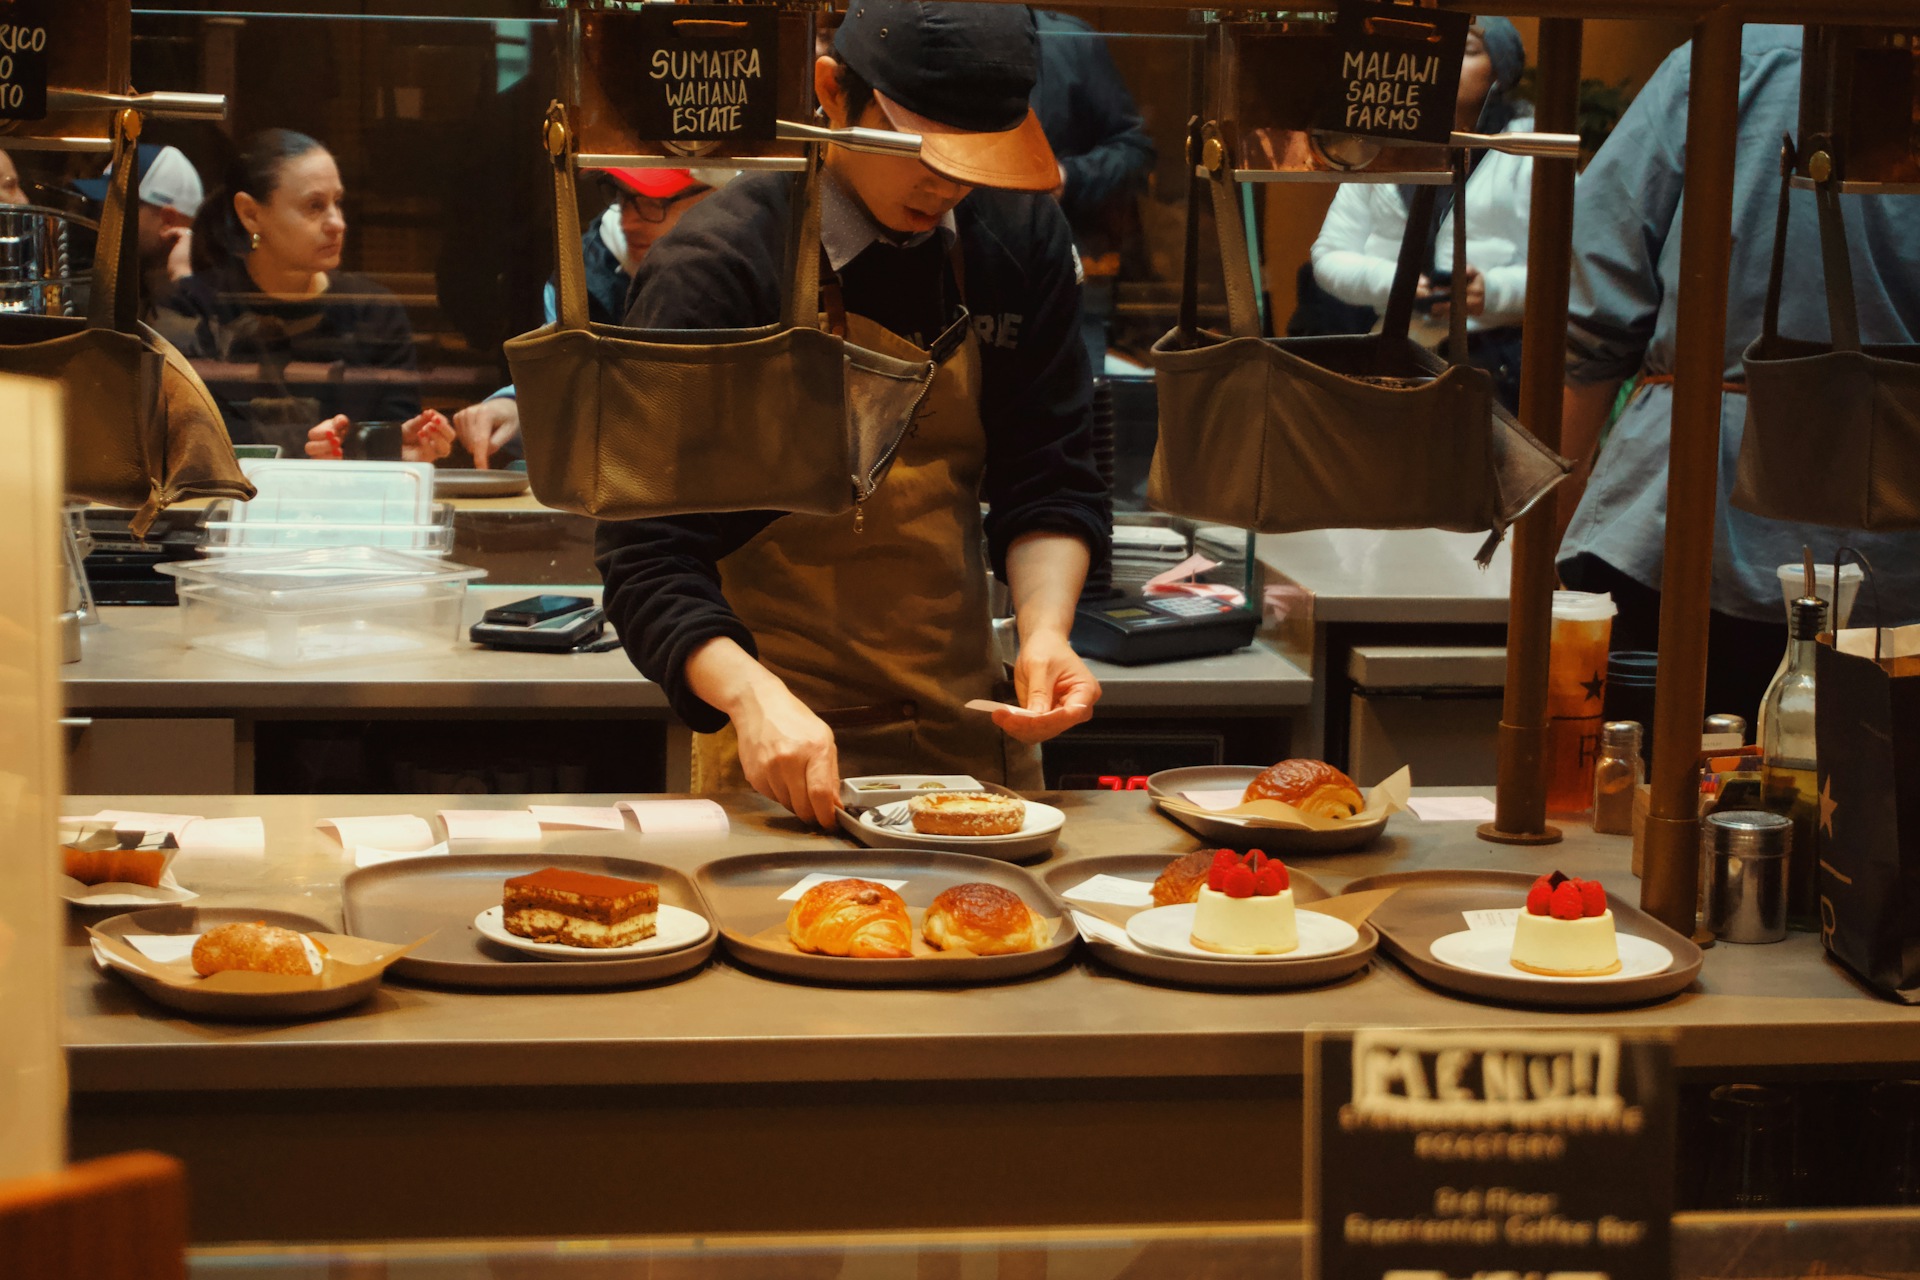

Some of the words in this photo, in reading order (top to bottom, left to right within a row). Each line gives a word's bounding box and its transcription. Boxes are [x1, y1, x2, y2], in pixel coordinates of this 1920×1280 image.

[649, 48, 761, 79] SUMATRA
[1342, 50, 1439, 84] MALAWI
[665, 79, 748, 106] WAHANA
[1346, 80, 1420, 106] SABLE
[673, 105, 742, 134] ESTATE
[1345, 103, 1421, 130] FARMS
[1363, 1048, 1593, 1101] MENU!
